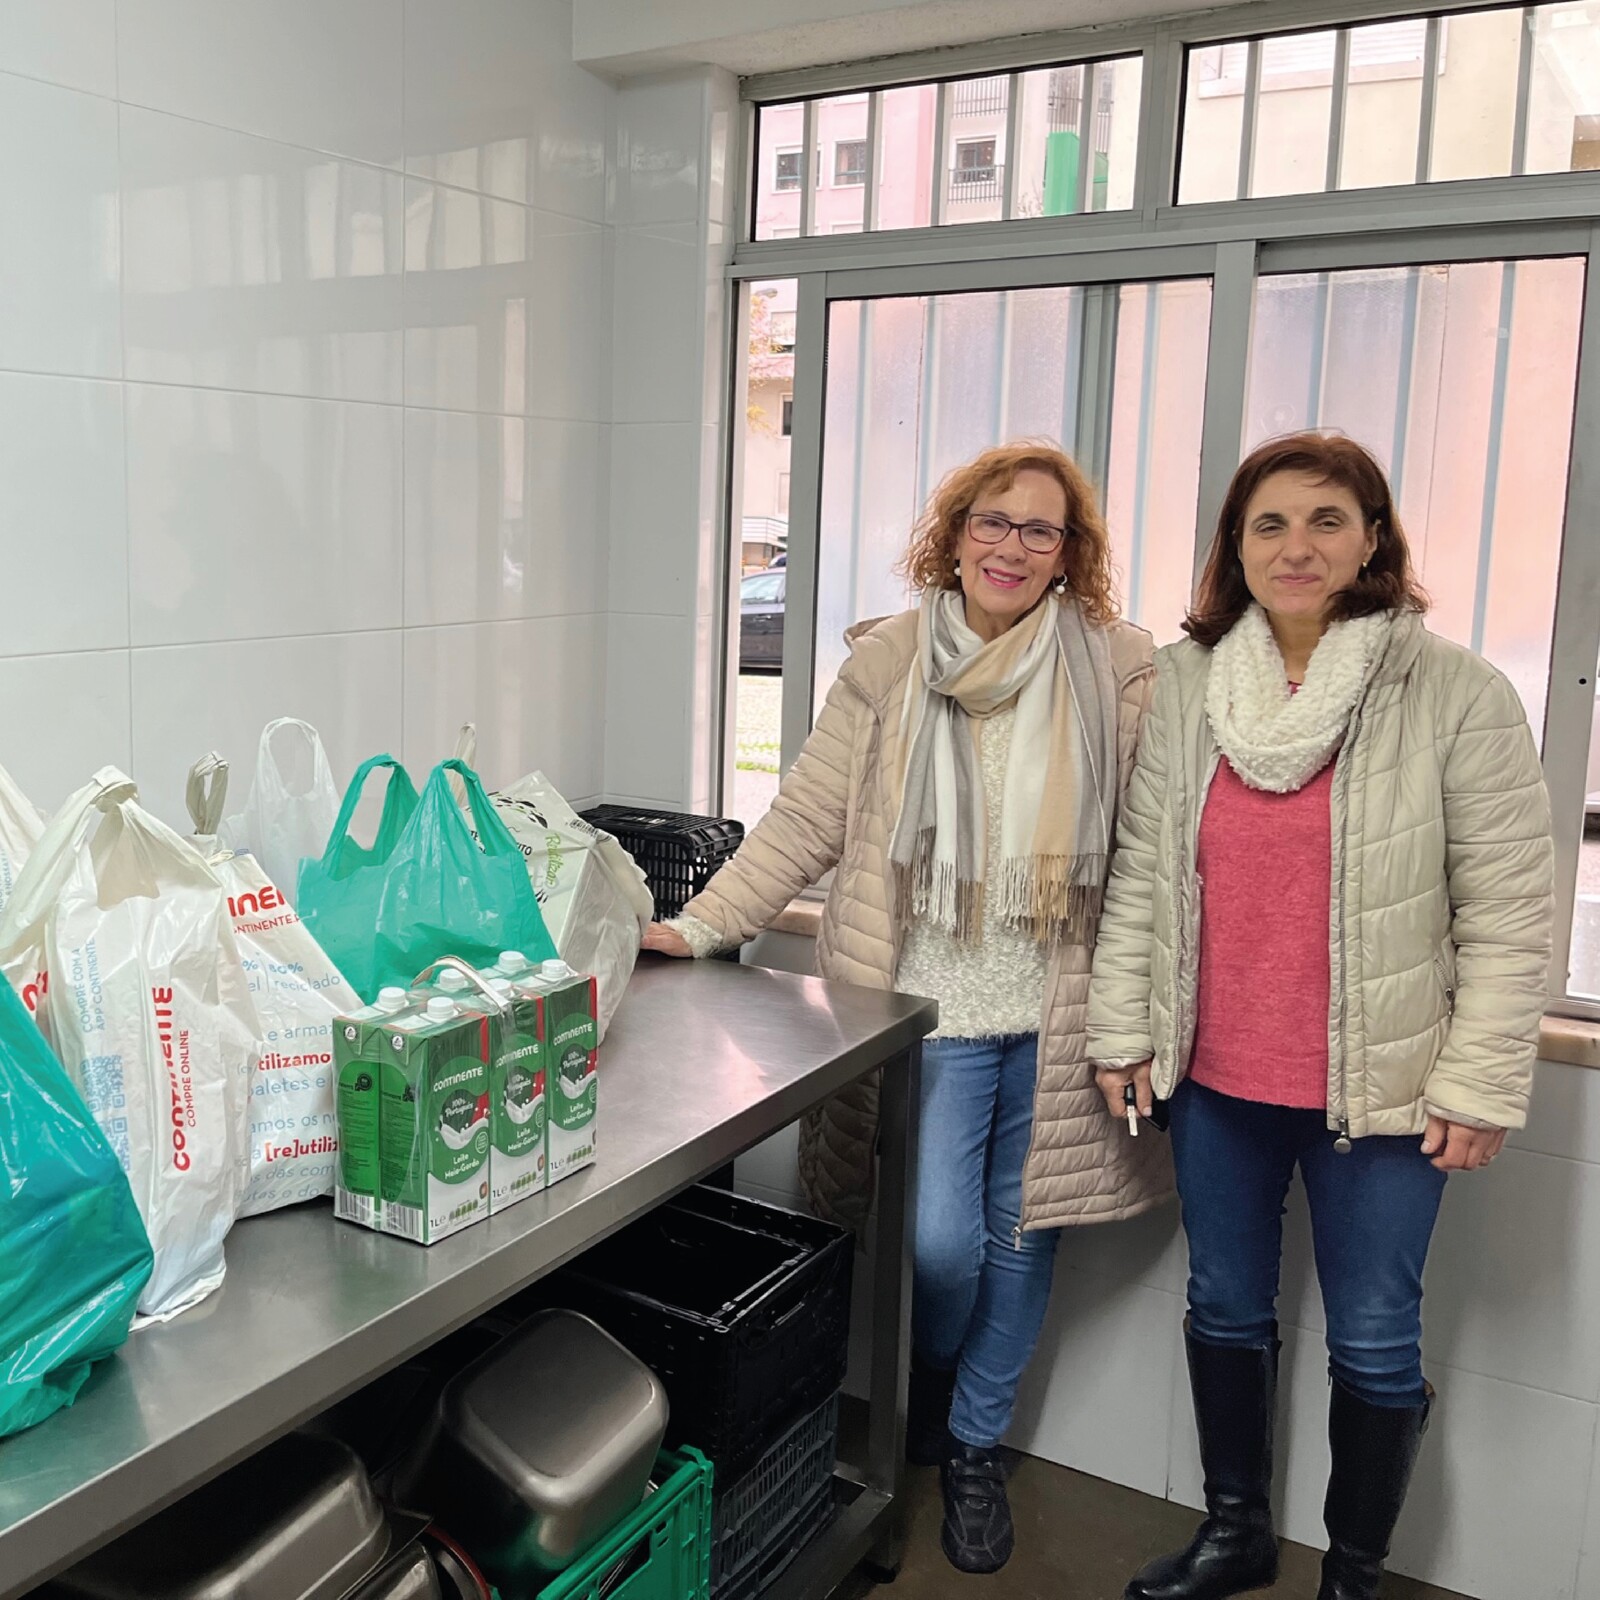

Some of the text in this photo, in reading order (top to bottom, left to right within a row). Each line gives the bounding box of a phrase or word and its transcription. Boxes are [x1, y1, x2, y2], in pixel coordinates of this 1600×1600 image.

[73, 959, 84, 982] COM
[86, 938, 105, 1031] APP CONTINENTE
[274, 973, 340, 992] reciclado
[75, 984, 93, 1033] COMPRE
[553, 1022, 593, 1046] CONTINENTE
[180, 1030, 196, 1128] COMPRE ONLINE
[316, 1077, 326, 1088] e
[433, 1066, 484, 1092] CONTINENTE
[301, 1114, 318, 1127] os
[507, 1133, 539, 1152] Meio-Gordo
[516, 1127, 531, 1139] Leite
[453, 1152, 469, 1165] Leite
[444, 1160, 480, 1180] Meio-Gordo
